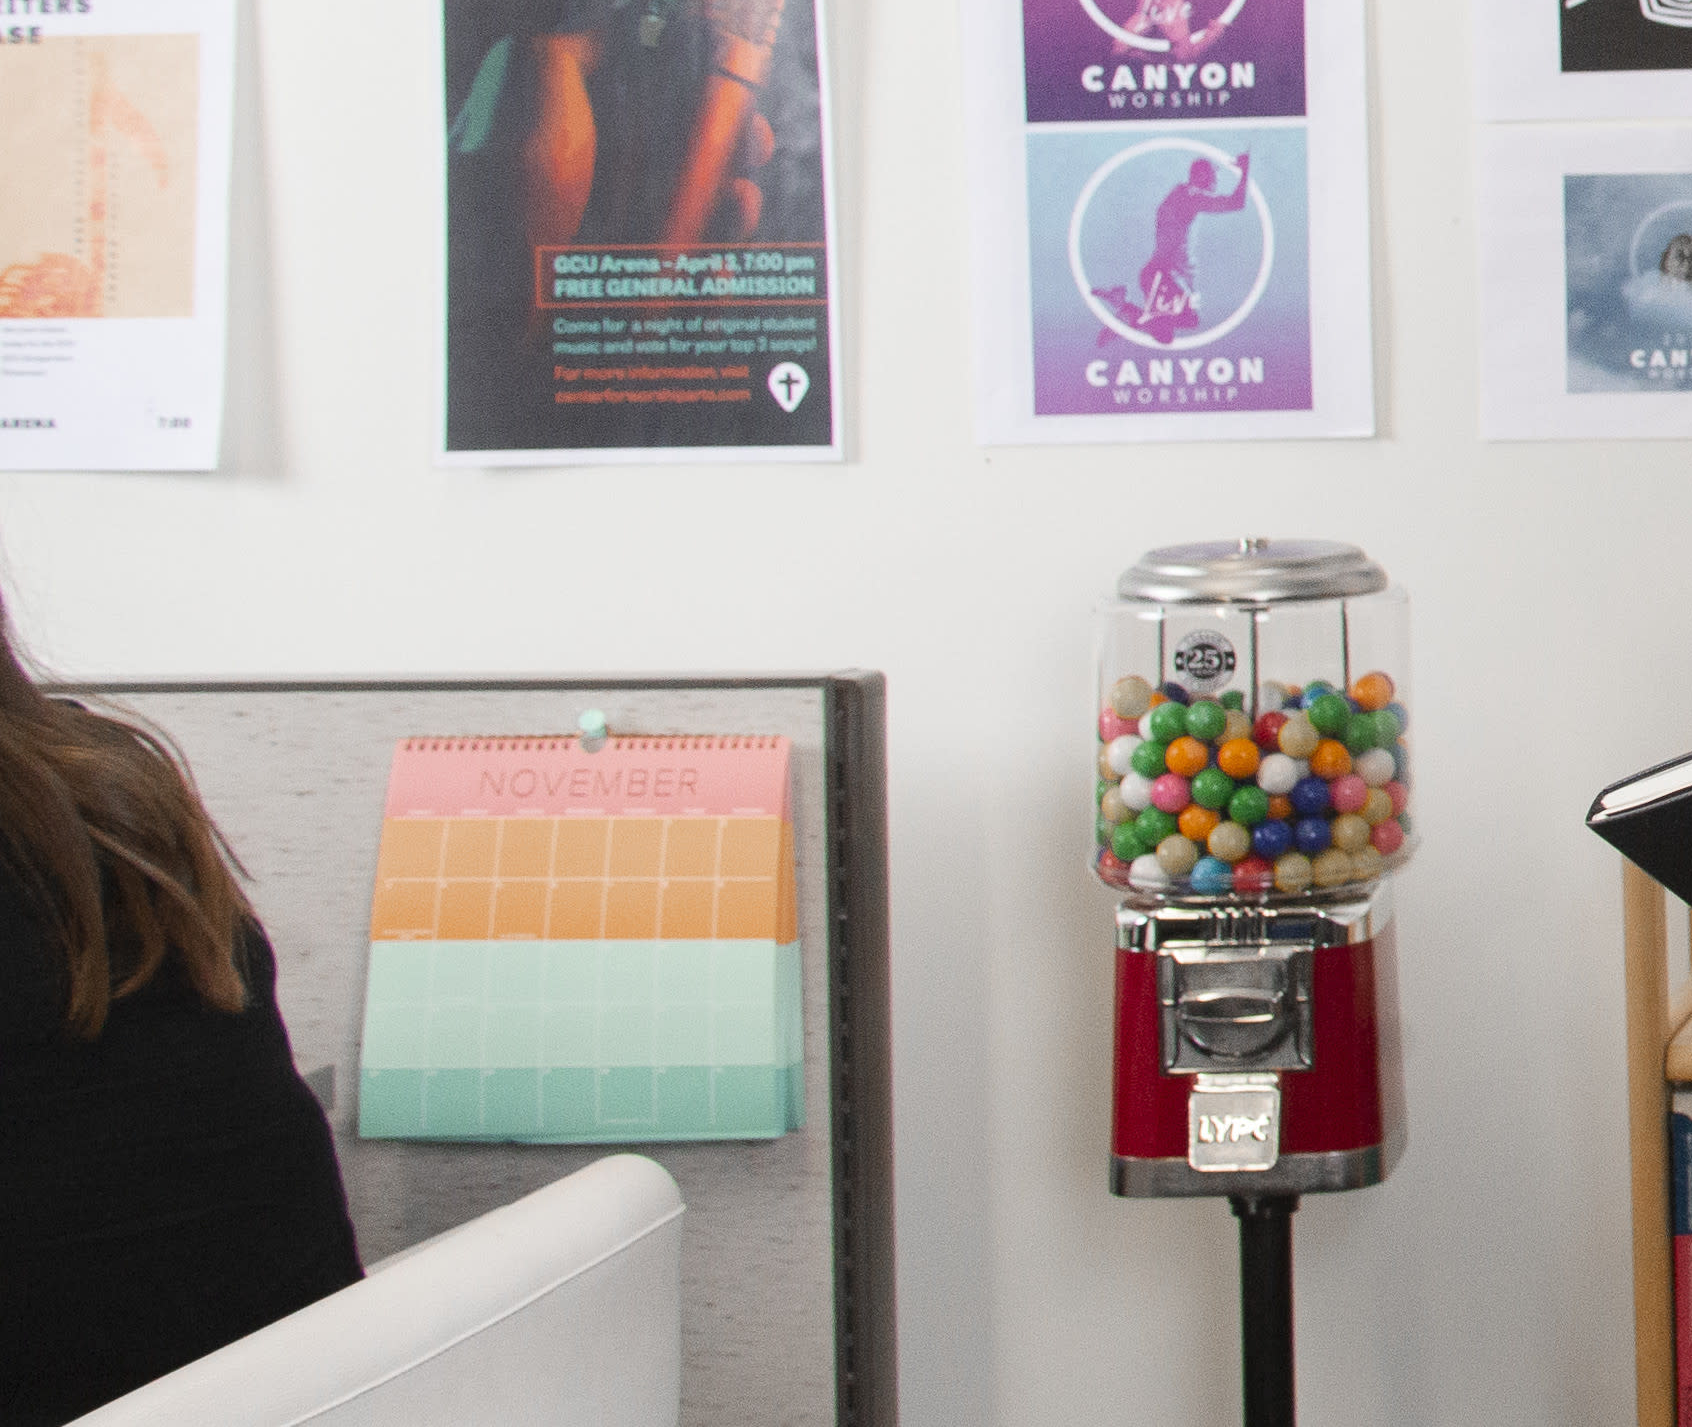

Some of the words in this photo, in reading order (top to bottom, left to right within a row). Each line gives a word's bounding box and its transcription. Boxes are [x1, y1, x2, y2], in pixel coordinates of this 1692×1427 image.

[0, 25, 42, 44] SE
[1081, 63, 1255, 92] CANYON
[1109, 91, 1230, 108] WORSHIP
[554, 254, 598, 274] GCU
[600, 254, 660, 274] Arena
[675, 254, 722, 274] April
[785, 256, 815, 275] pm
[554, 278, 603, 298] FREE
[605, 277, 698, 297] GENERAL
[700, 275, 816, 296] ADMISSION
[553, 317, 600, 333] Come
[1085, 357, 1265, 387] CANYON
[1112, 386, 1238, 404] WORSHIP
[479, 767, 701, 799] NOVEMBER
